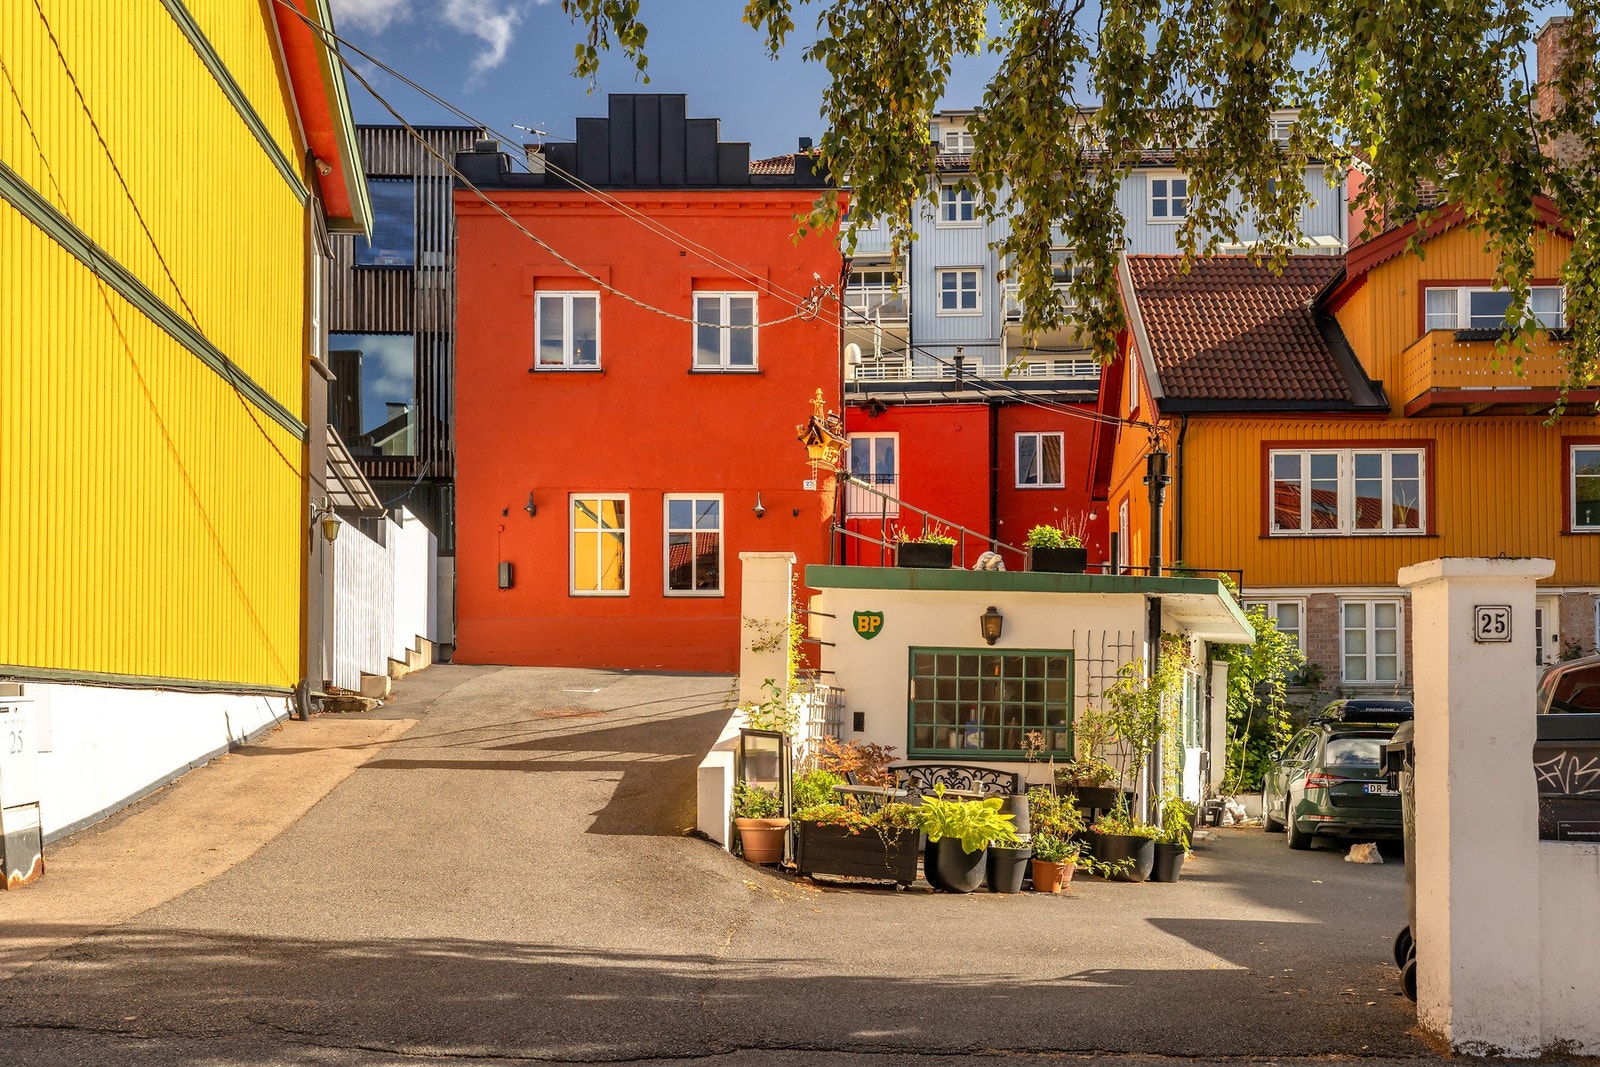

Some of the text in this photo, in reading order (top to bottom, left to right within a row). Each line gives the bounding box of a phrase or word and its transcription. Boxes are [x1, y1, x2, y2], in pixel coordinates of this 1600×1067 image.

[857, 615, 881, 633] BP
[1481, 613, 1506, 633] 25
[9, 730, 23, 755] 25
[1370, 784, 1382, 793] DR
